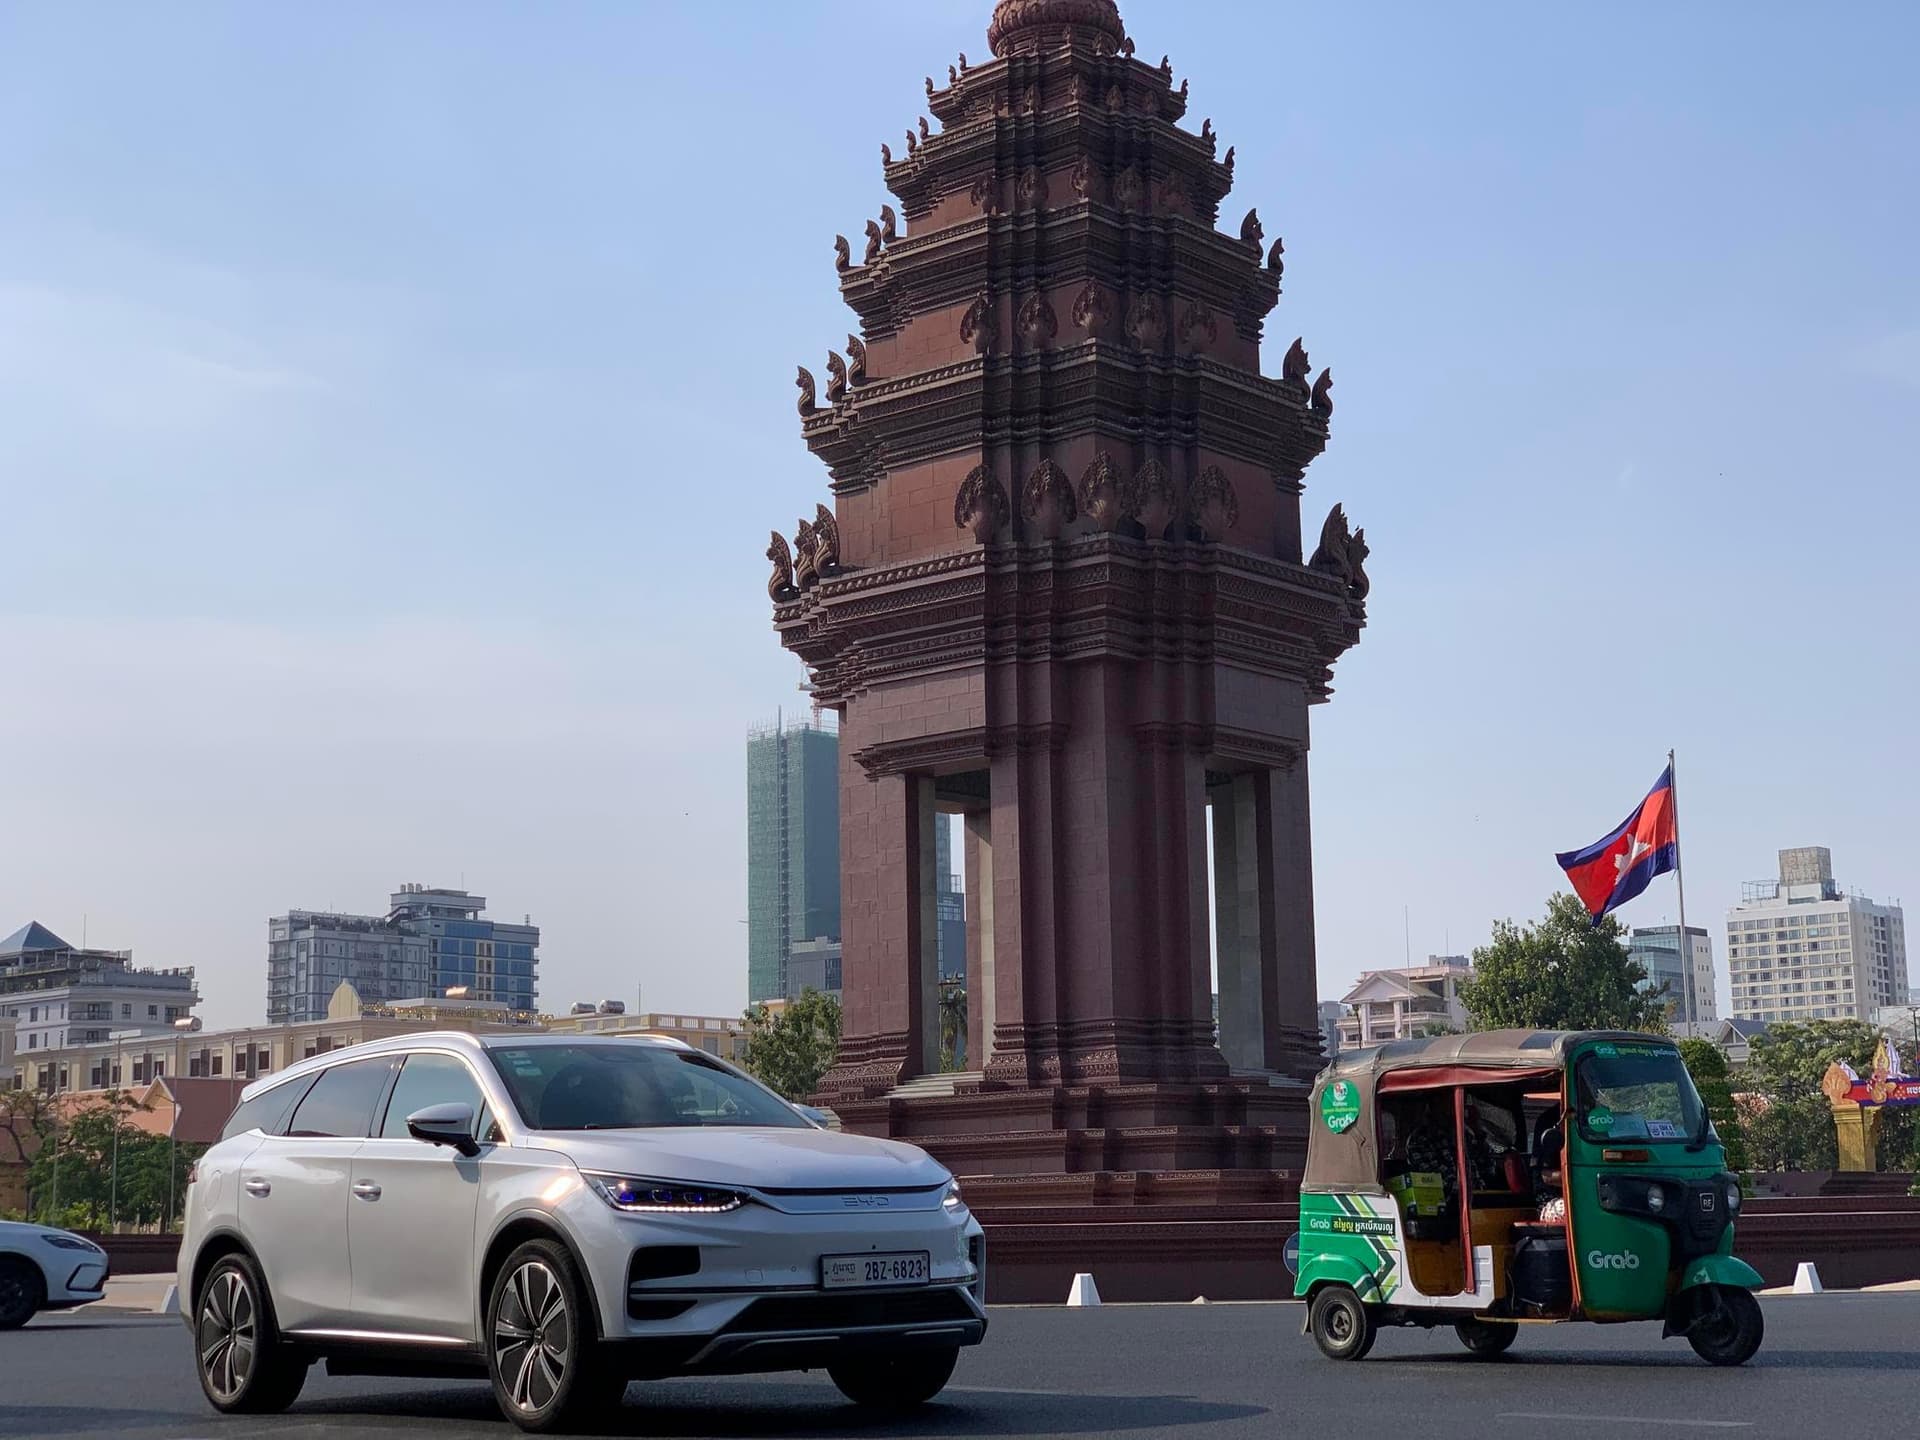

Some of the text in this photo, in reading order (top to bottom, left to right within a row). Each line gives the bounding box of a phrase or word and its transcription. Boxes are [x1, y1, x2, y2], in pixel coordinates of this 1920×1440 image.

[1327, 1112, 1355, 1129] Grab
[1588, 1114, 1614, 1126] Grab
[841, 1195, 890, 1207] BYD
[1310, 1218, 1331, 1229] Grab
[1588, 1249, 1640, 1269] Grab
[864, 1259, 923, 1281] 2BZ-6823
